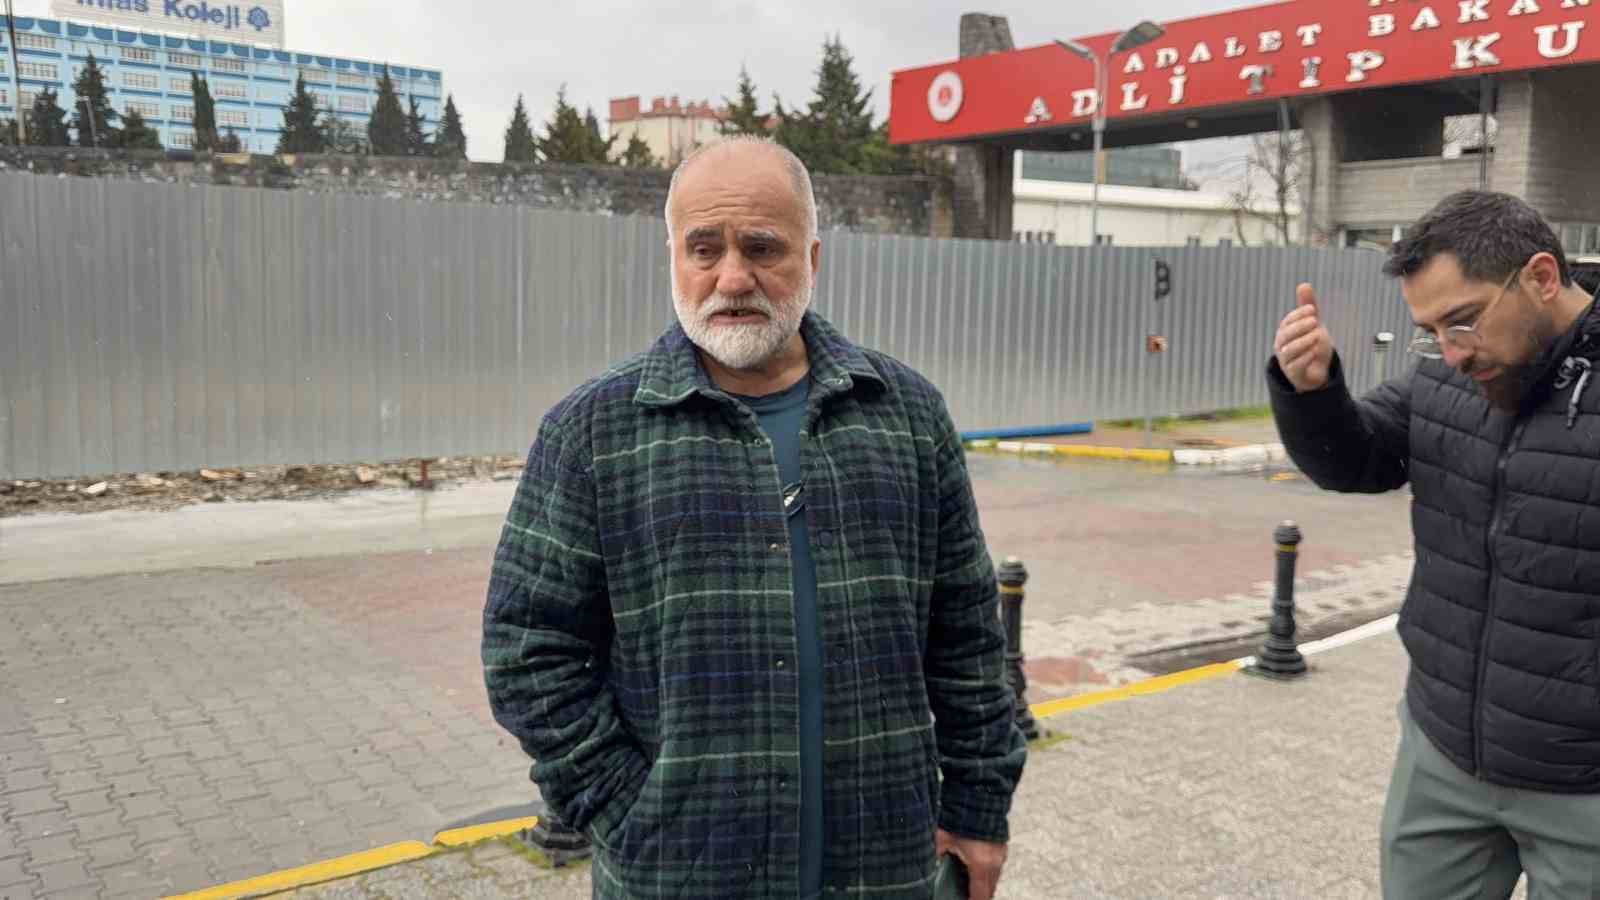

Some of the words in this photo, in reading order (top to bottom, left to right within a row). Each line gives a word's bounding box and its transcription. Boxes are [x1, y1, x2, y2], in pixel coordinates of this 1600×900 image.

[1123, 24, 1322, 73] ADALET
[1239, 50, 1384, 95] TIP
[1452, 21, 1585, 70] KU
